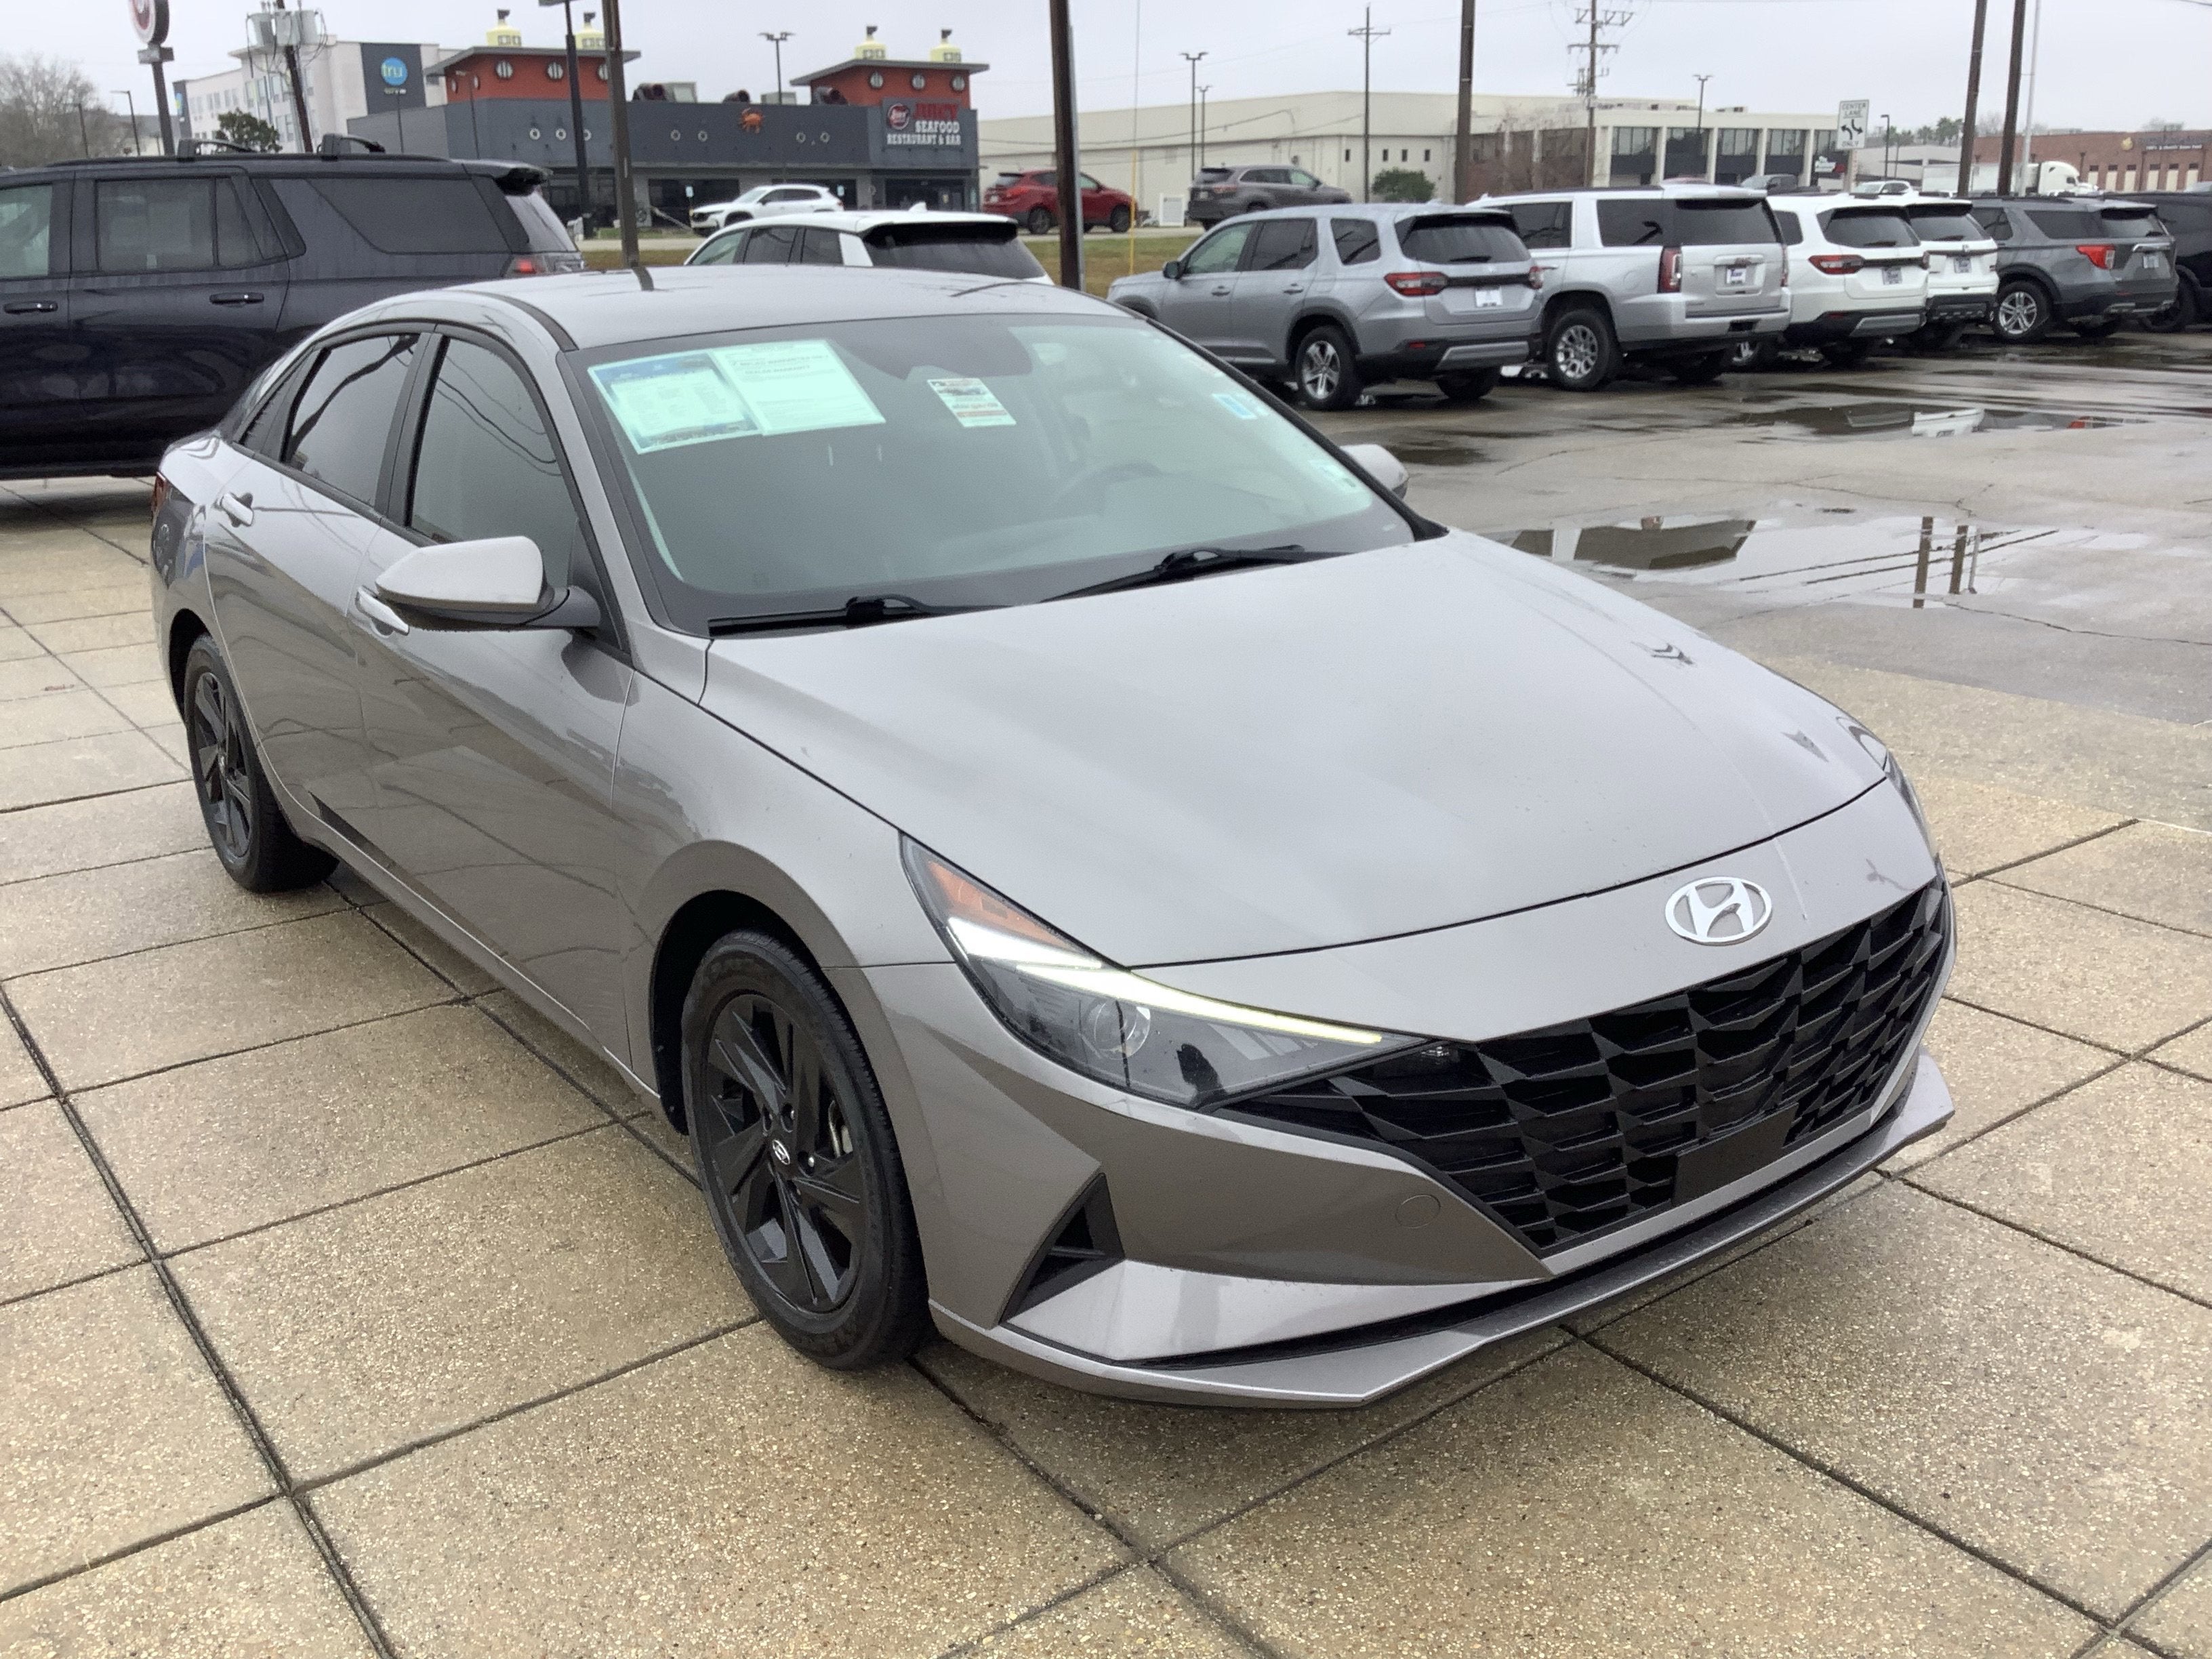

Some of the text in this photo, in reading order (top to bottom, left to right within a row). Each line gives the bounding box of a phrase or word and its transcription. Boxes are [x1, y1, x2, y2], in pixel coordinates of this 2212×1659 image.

[380, 63, 403, 78] tru
[1841, 102, 1866, 110] CENTER
[915, 120, 960, 134] SEAFOOD
[886, 134, 937, 145] RESTAURANT
[945, 134, 961, 145] BAR
